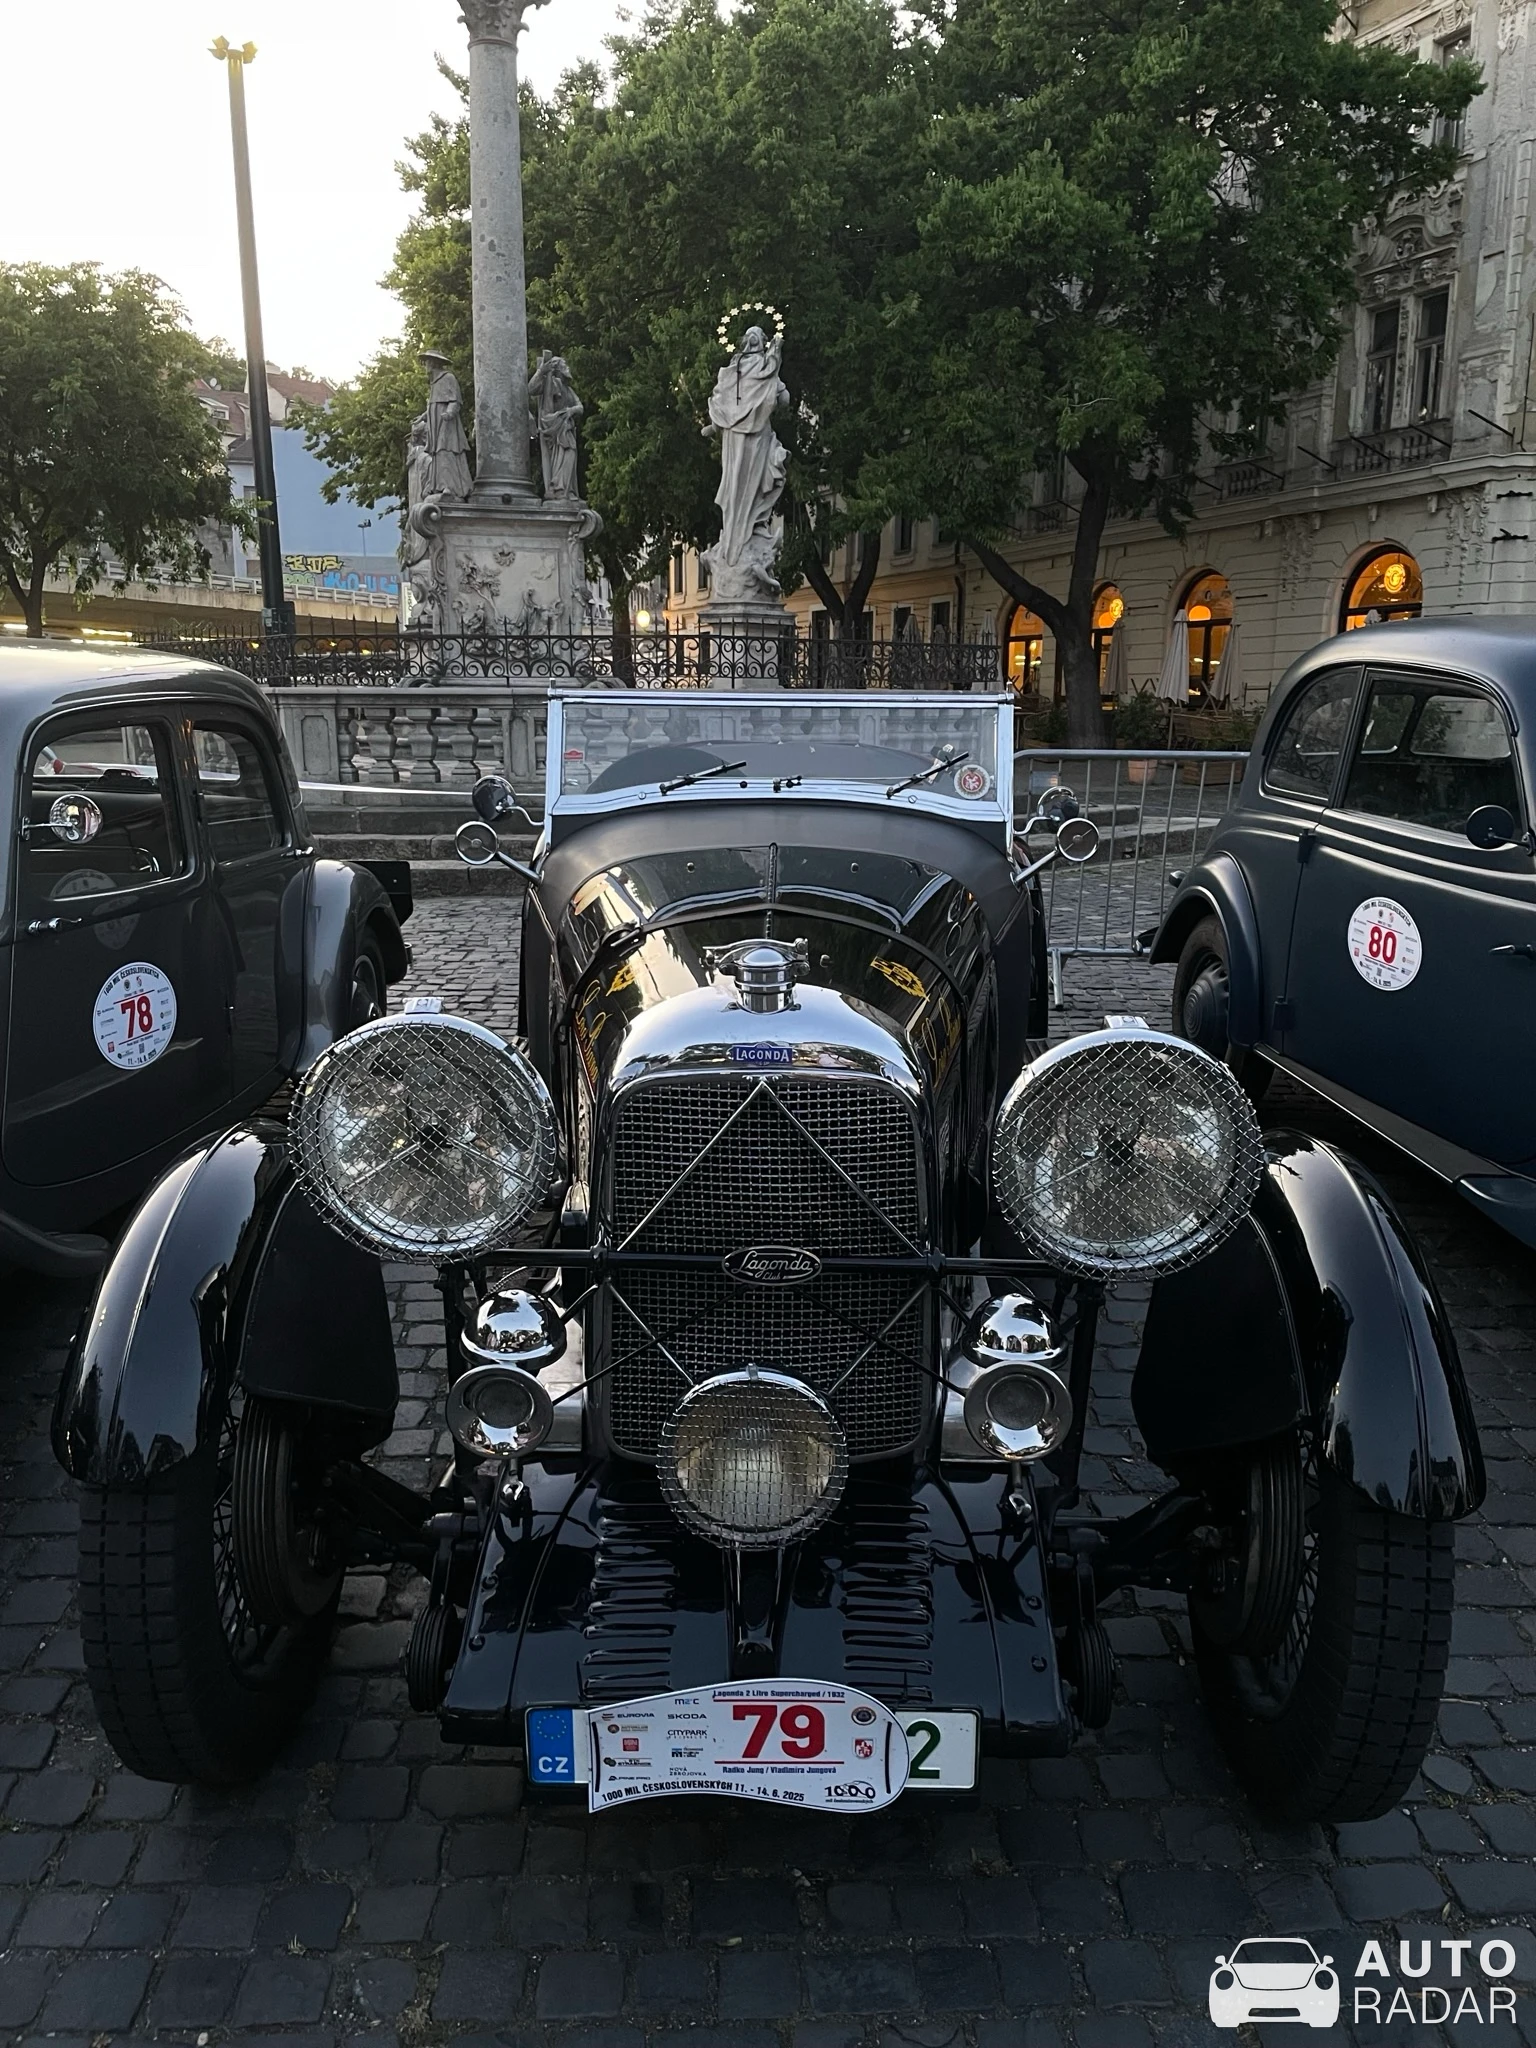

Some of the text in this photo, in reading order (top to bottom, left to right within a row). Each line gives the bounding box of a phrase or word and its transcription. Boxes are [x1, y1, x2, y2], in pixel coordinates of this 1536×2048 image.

[1369, 926, 1397, 964] 80
[120, 995, 153, 1038] 78
[736, 1048, 789, 1062] LAGONDA
[731, 1250, 813, 1279] Lagonda
[712, 1690, 744, 1698] Lagonda
[771, 1690, 820, 1698] Supercharged
[733, 1704, 825, 1759] 79
[906, 1720, 941, 1779] 2
[538, 1756, 569, 1773] CZ
[747, 1767, 764, 1775] Jung
[806, 1766, 836, 1775] Jungová
[602, 1789, 623, 1802] 1000
[624, 1786, 641, 1796] MIL
[735, 1783, 748, 1793] 11.
[757, 1786, 769, 1796] 14.
[772, 1789, 780, 1798] 6.
[783, 1790, 804, 1801] 2025
